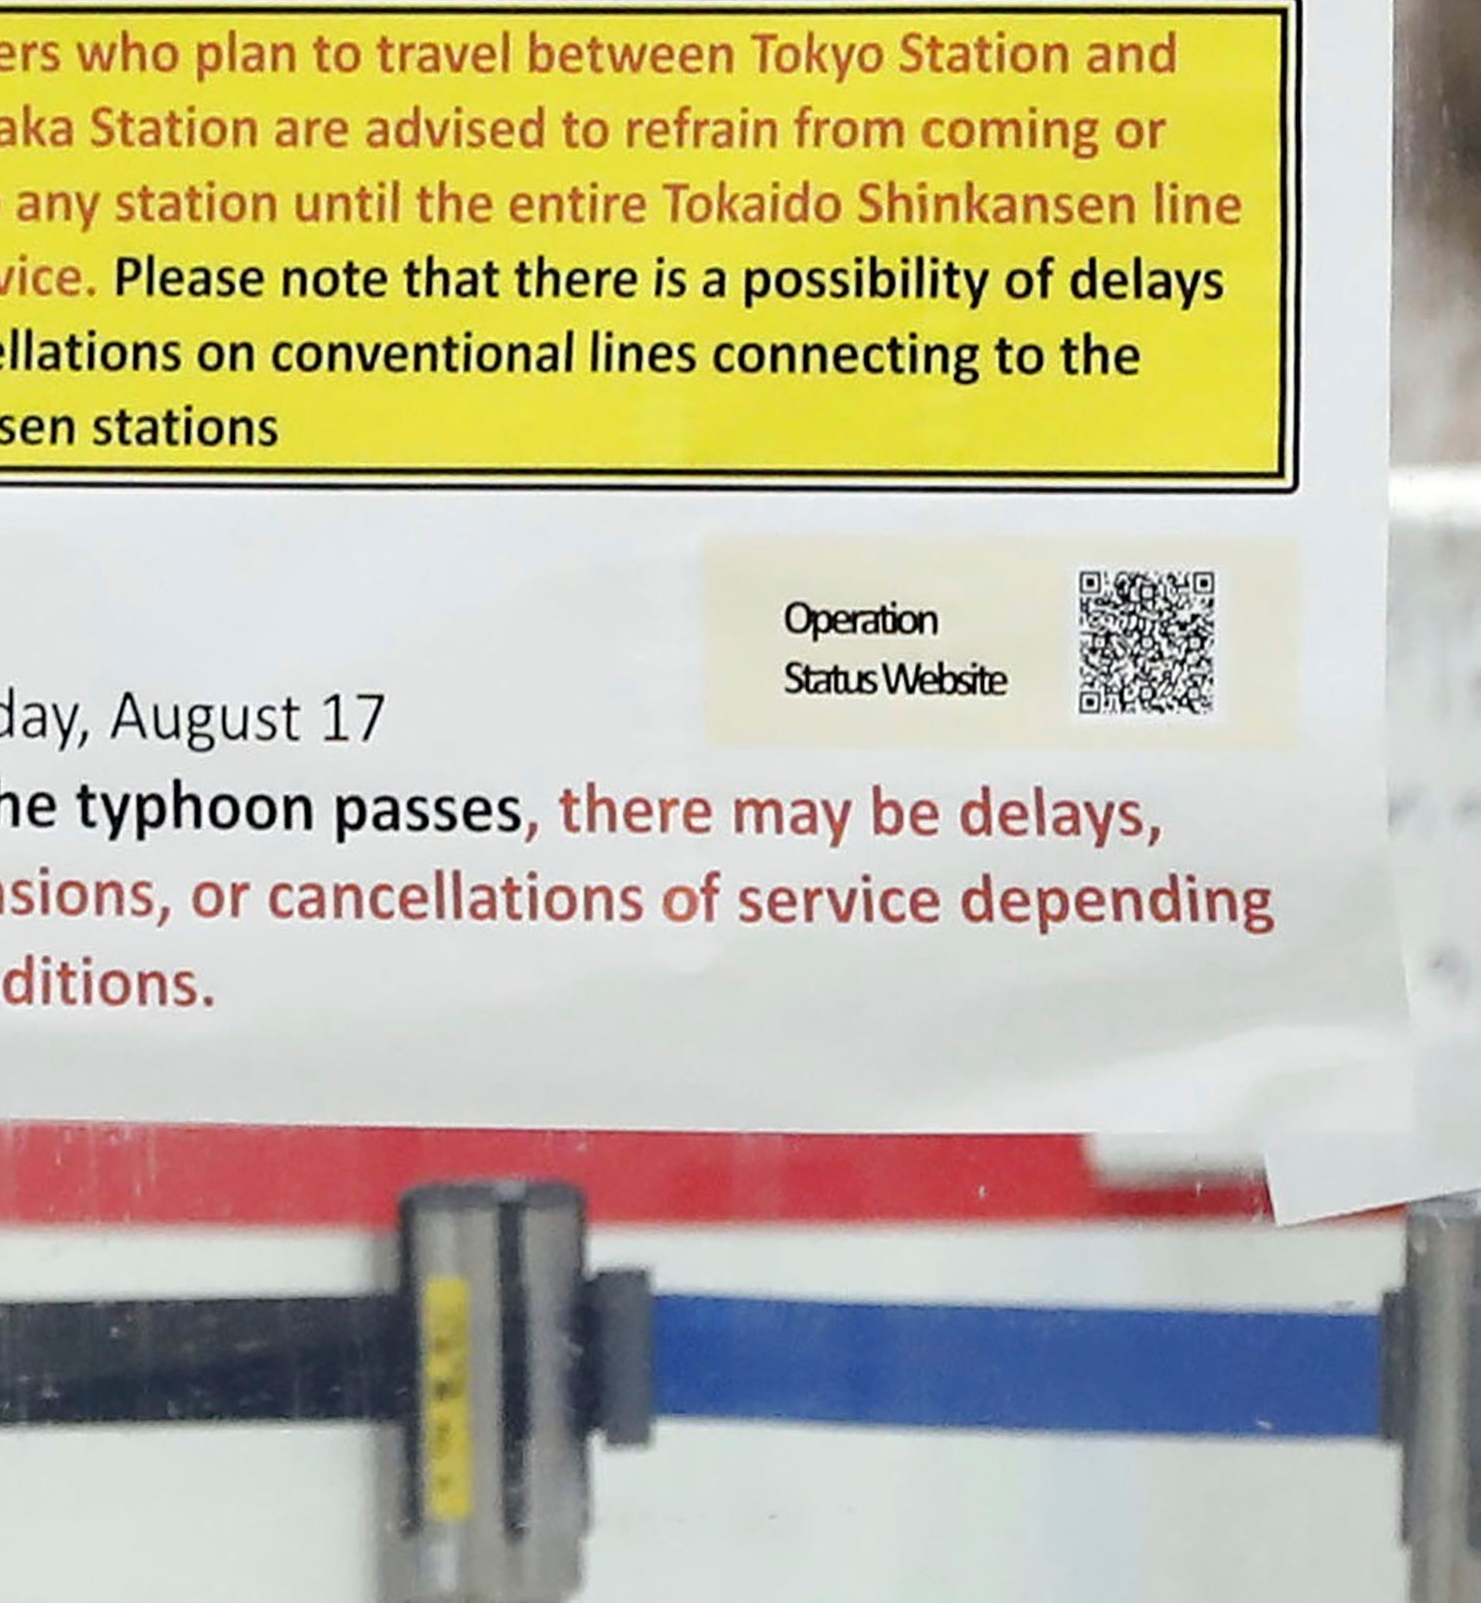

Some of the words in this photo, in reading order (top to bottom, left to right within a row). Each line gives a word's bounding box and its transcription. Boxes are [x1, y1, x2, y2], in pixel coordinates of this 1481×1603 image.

[76, 30, 179, 72] who
[197, 30, 295, 83] plan
[313, 35, 361, 73] to
[376, 30, 509, 73] travel
[529, 30, 733, 73] between
[751, 31, 883, 84] Tokyo
[900, 31, 1068, 73] Station
[1087, 31, 1176, 73] and
[17, 191, 101, 233] any
[116, 180, 276, 222] station
[296, 180, 399, 223] until
[416, 180, 492, 223] the
[510, 182, 646, 223] entire
[662, 180, 841, 223] Tokaido
[858, 180, 1135, 224] Shinkansen
[1155, 181, 1241, 224] line
[117, 254, 264, 297] Please
[283, 260, 387, 297] note
[404, 255, 499, 298] that
[515, 255, 637, 298] there
[655, 257, 686, 297] is
[703, 268, 725, 297] a
[745, 255, 989, 309] possibility
[1005, 256, 1055, 299] of
[1071, 256, 1223, 310] delays
[198, 342, 254, 372] on
[272, 330, 573, 373] conventional
[591, 330, 696, 373] lines
[714, 332, 979, 385] connecting
[994, 337, 1044, 375] to
[1060, 332, 1140, 375] the
[93, 405, 278, 447] stations
[785, 601, 938, 642] Operation
[785, 662, 878, 694] Status
[882, 661, 1008, 695] Website
[111, 691, 300, 752] August
[324, 694, 384, 741] 17
[76, 778, 312, 841] typhoon
[336, 795, 537, 844] passes,
[559, 783, 711, 833] there
[735, 799, 851, 847] may
[873, 785, 938, 835] be
[961, 786, 1160, 848] delays,
[192, 882, 250, 917] or
[269, 869, 643, 922] cancellations
[663, 871, 721, 922] of
[739, 874, 940, 923] service
[962, 873, 1274, 935] depending
